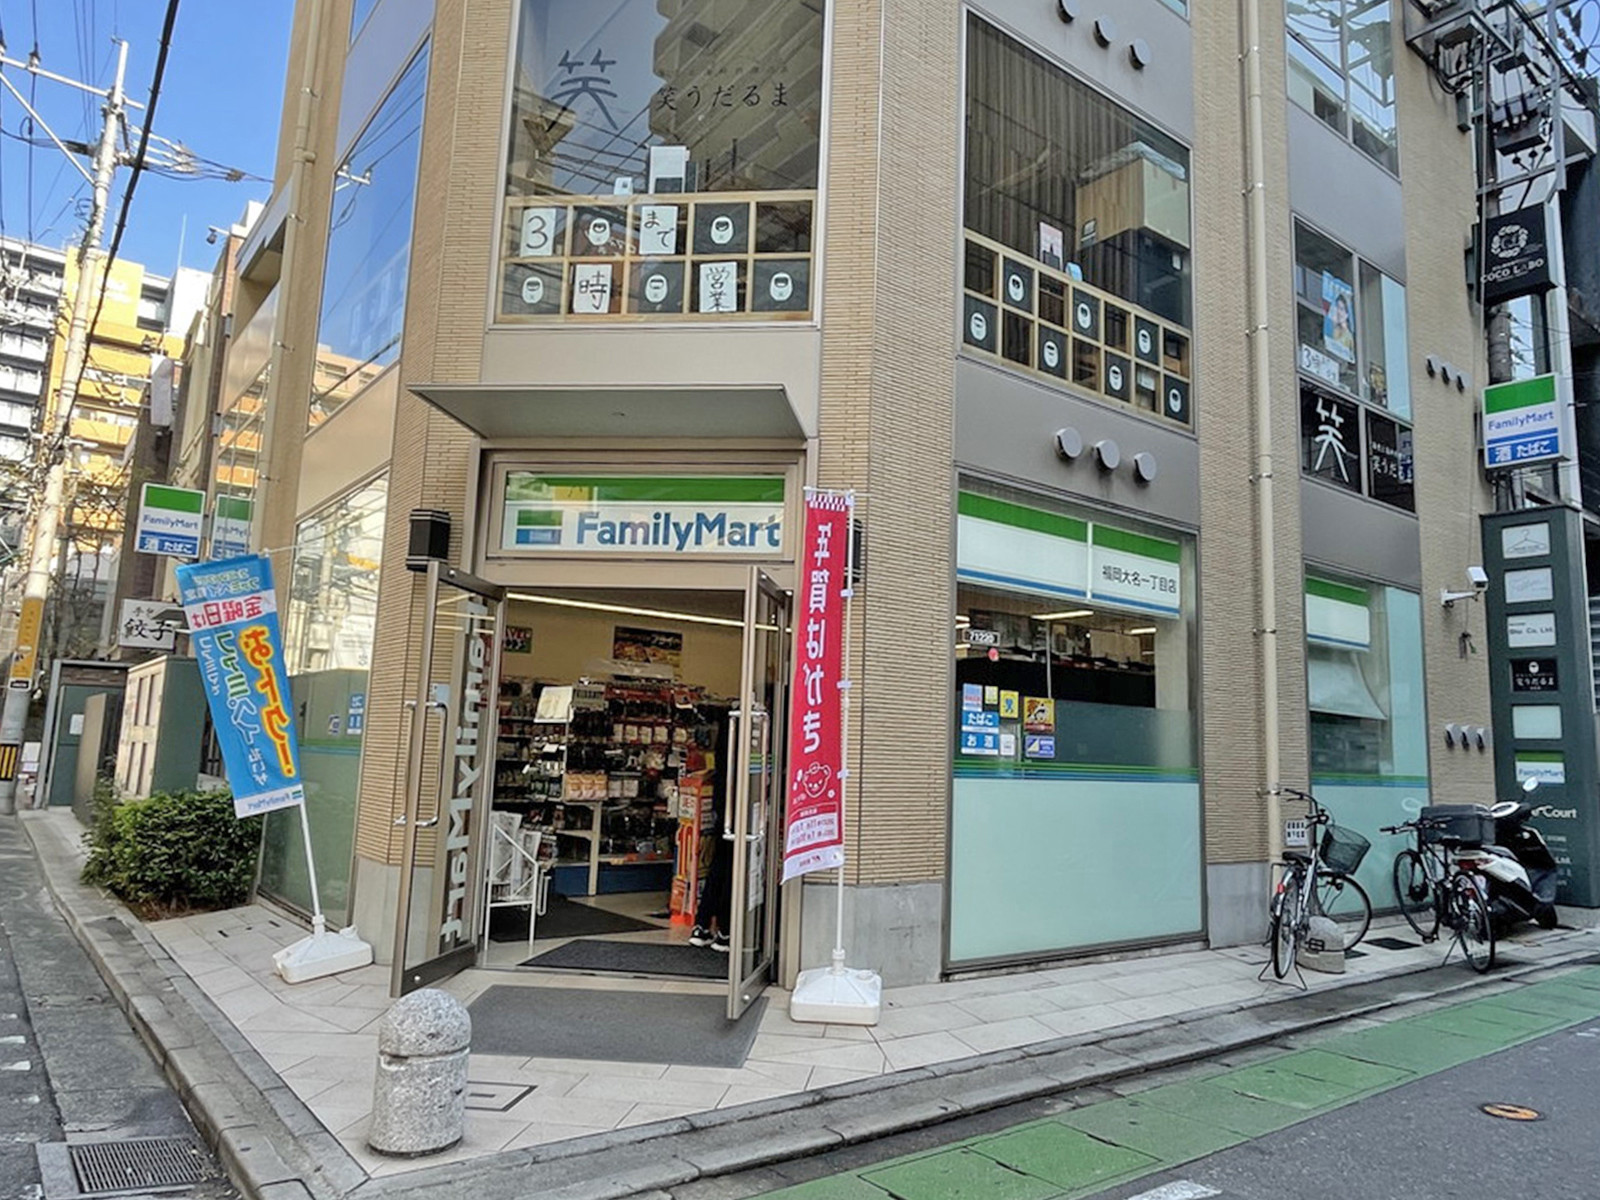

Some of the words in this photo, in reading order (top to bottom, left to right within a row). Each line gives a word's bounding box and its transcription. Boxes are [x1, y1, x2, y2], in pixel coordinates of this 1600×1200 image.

[655, 82, 789, 111] 笑うだるま
[525, 216, 548, 249] 3
[579, 270, 607, 310] 時
[643, 211, 675, 248] まで
[707, 266, 731, 312] 営業
[1488, 411, 1554, 430] FamilyMart
[1516, 440, 1551, 458] たばこ
[143, 514, 199, 530] FamilyMart
[577, 512, 781, 551] FamilyMart
[163, 541, 193, 554] たばこ
[1102, 565, 1177, 594] 福岡大名一丁目店
[124, 618, 173, 641] 餃子
[967, 712, 994, 726] たばこ
[1518, 767, 1563, 777] FamilyMart
[1543, 805, 1577, 819] Court
